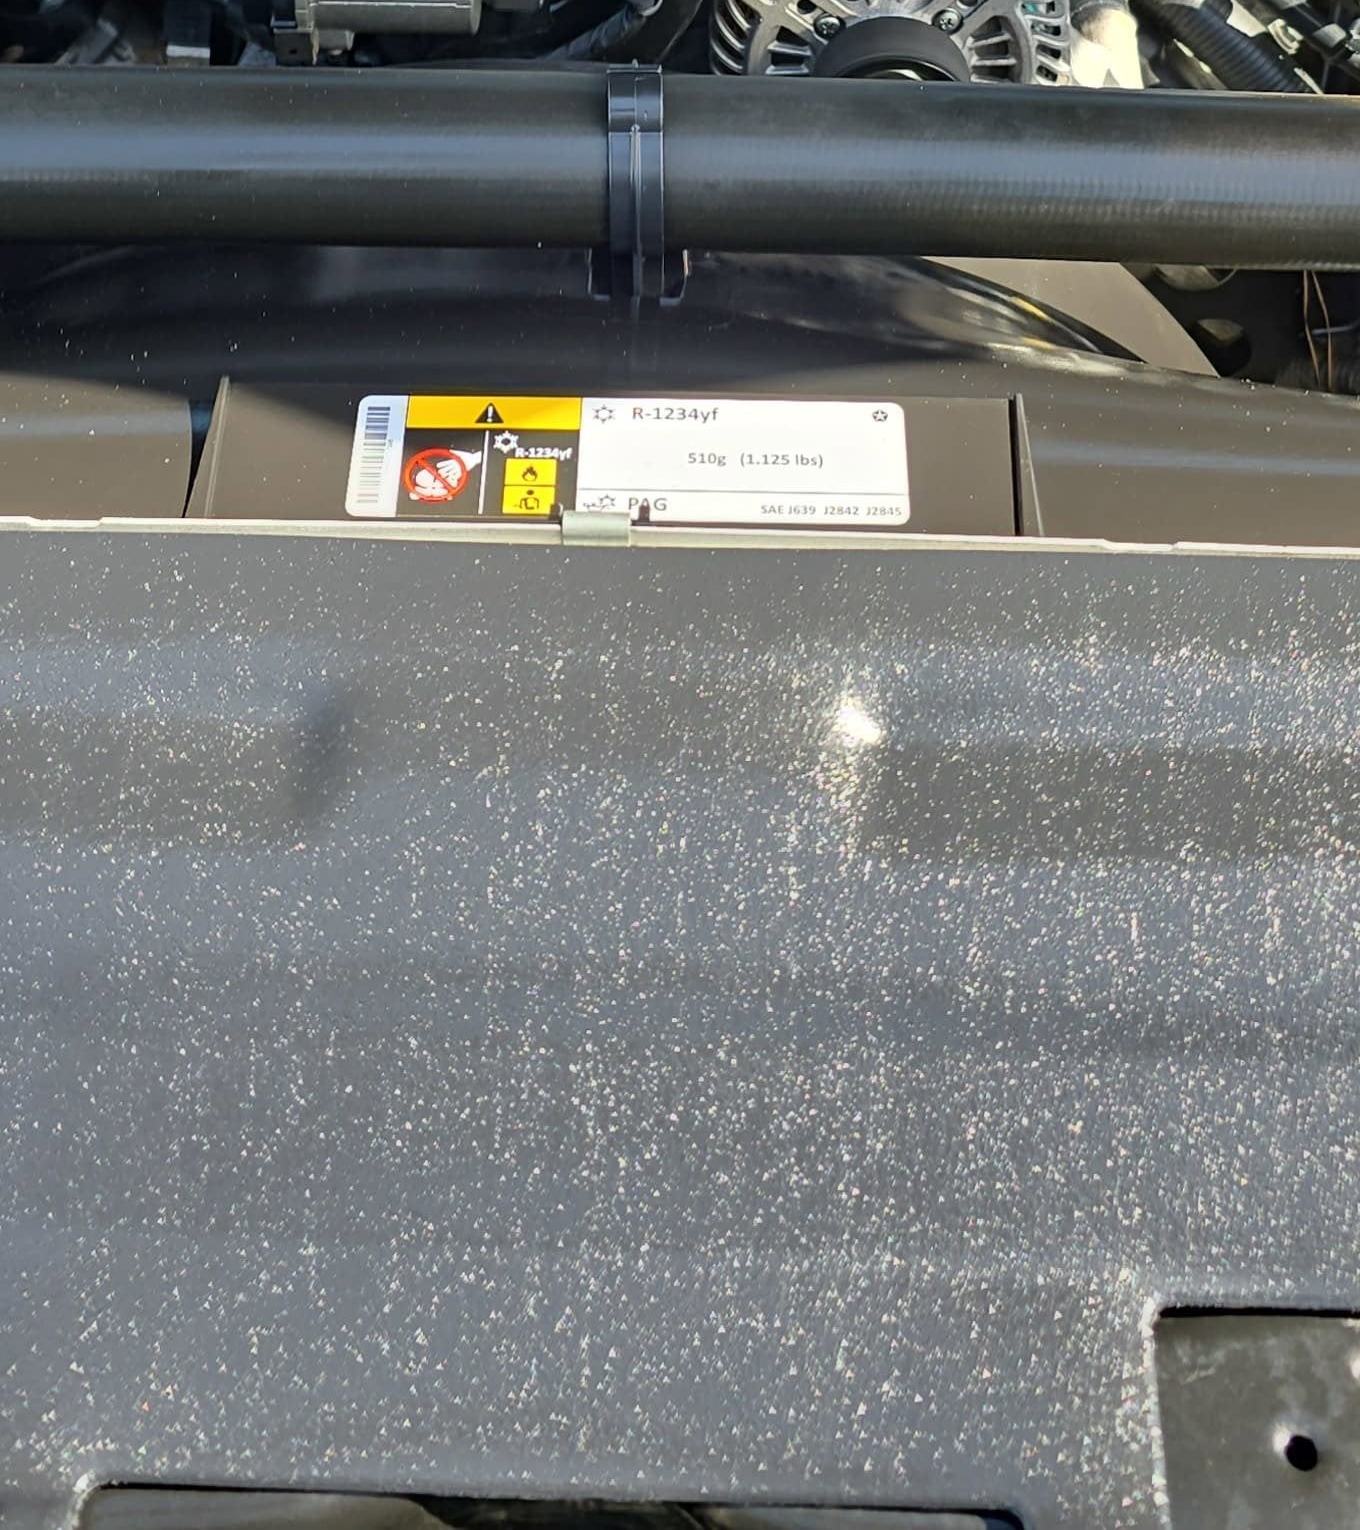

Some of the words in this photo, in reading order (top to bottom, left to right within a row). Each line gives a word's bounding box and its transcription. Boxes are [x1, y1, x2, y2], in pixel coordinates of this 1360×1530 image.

[632, 406, 720, 424] R-1234yf
[514, 446, 573, 462] R-1234yf
[687, 452, 727, 467] 510g
[739, 452, 791, 468] (1.125
[794, 453, 824, 469] lbs)
[627, 496, 668, 512] PAG
[760, 504, 784, 516] SAE
[788, 504, 817, 516] J639
[823, 505, 860, 517] J2842
[865, 506, 903, 517] J2845
